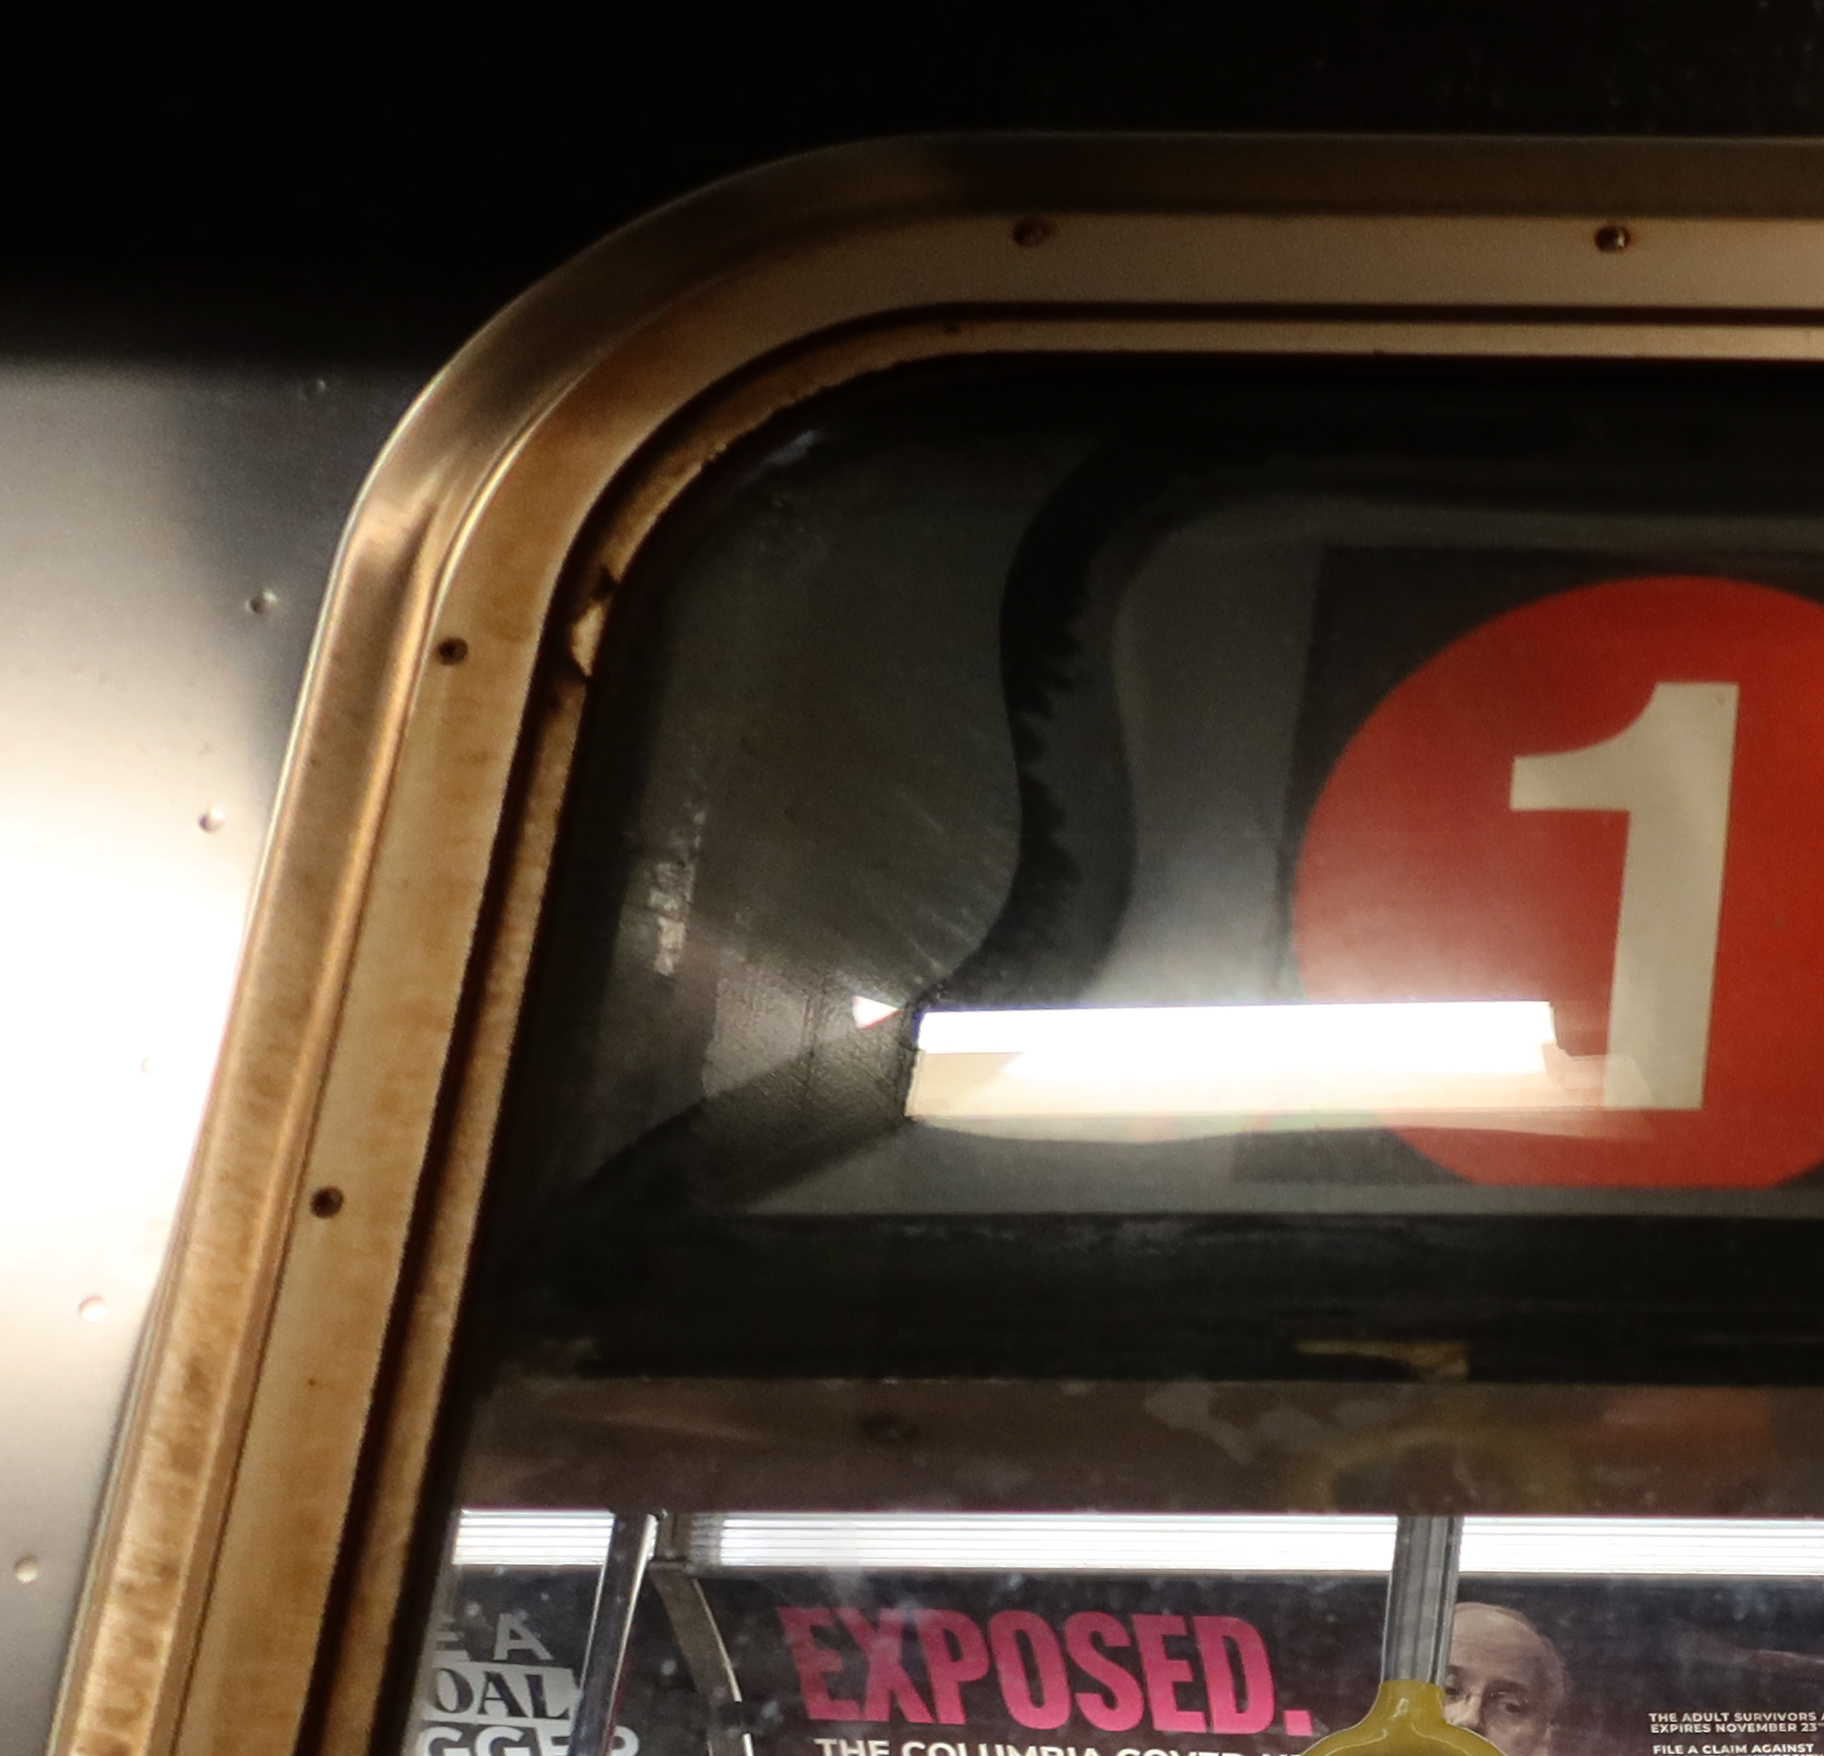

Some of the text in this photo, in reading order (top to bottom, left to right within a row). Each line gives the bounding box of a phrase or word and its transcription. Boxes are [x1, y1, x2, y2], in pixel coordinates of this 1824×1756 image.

[1508, 681, 1739, 1111] 1
[493, 1613, 554, 1660] A
[777, 1606, 1315, 1737] EXPOSED.
[1648, 1712, 1678, 1723] THE
[1682, 1712, 1730, 1723] ADULT
[1734, 1711, 1818, 1723] SURVIVORS
[1651, 1723, 1711, 1734] EXPIRES
[1715, 1722, 1797, 1733] NOVEMBER
[1653, 1743, 1815, 1755] FILE A CLAIM AGAINST
